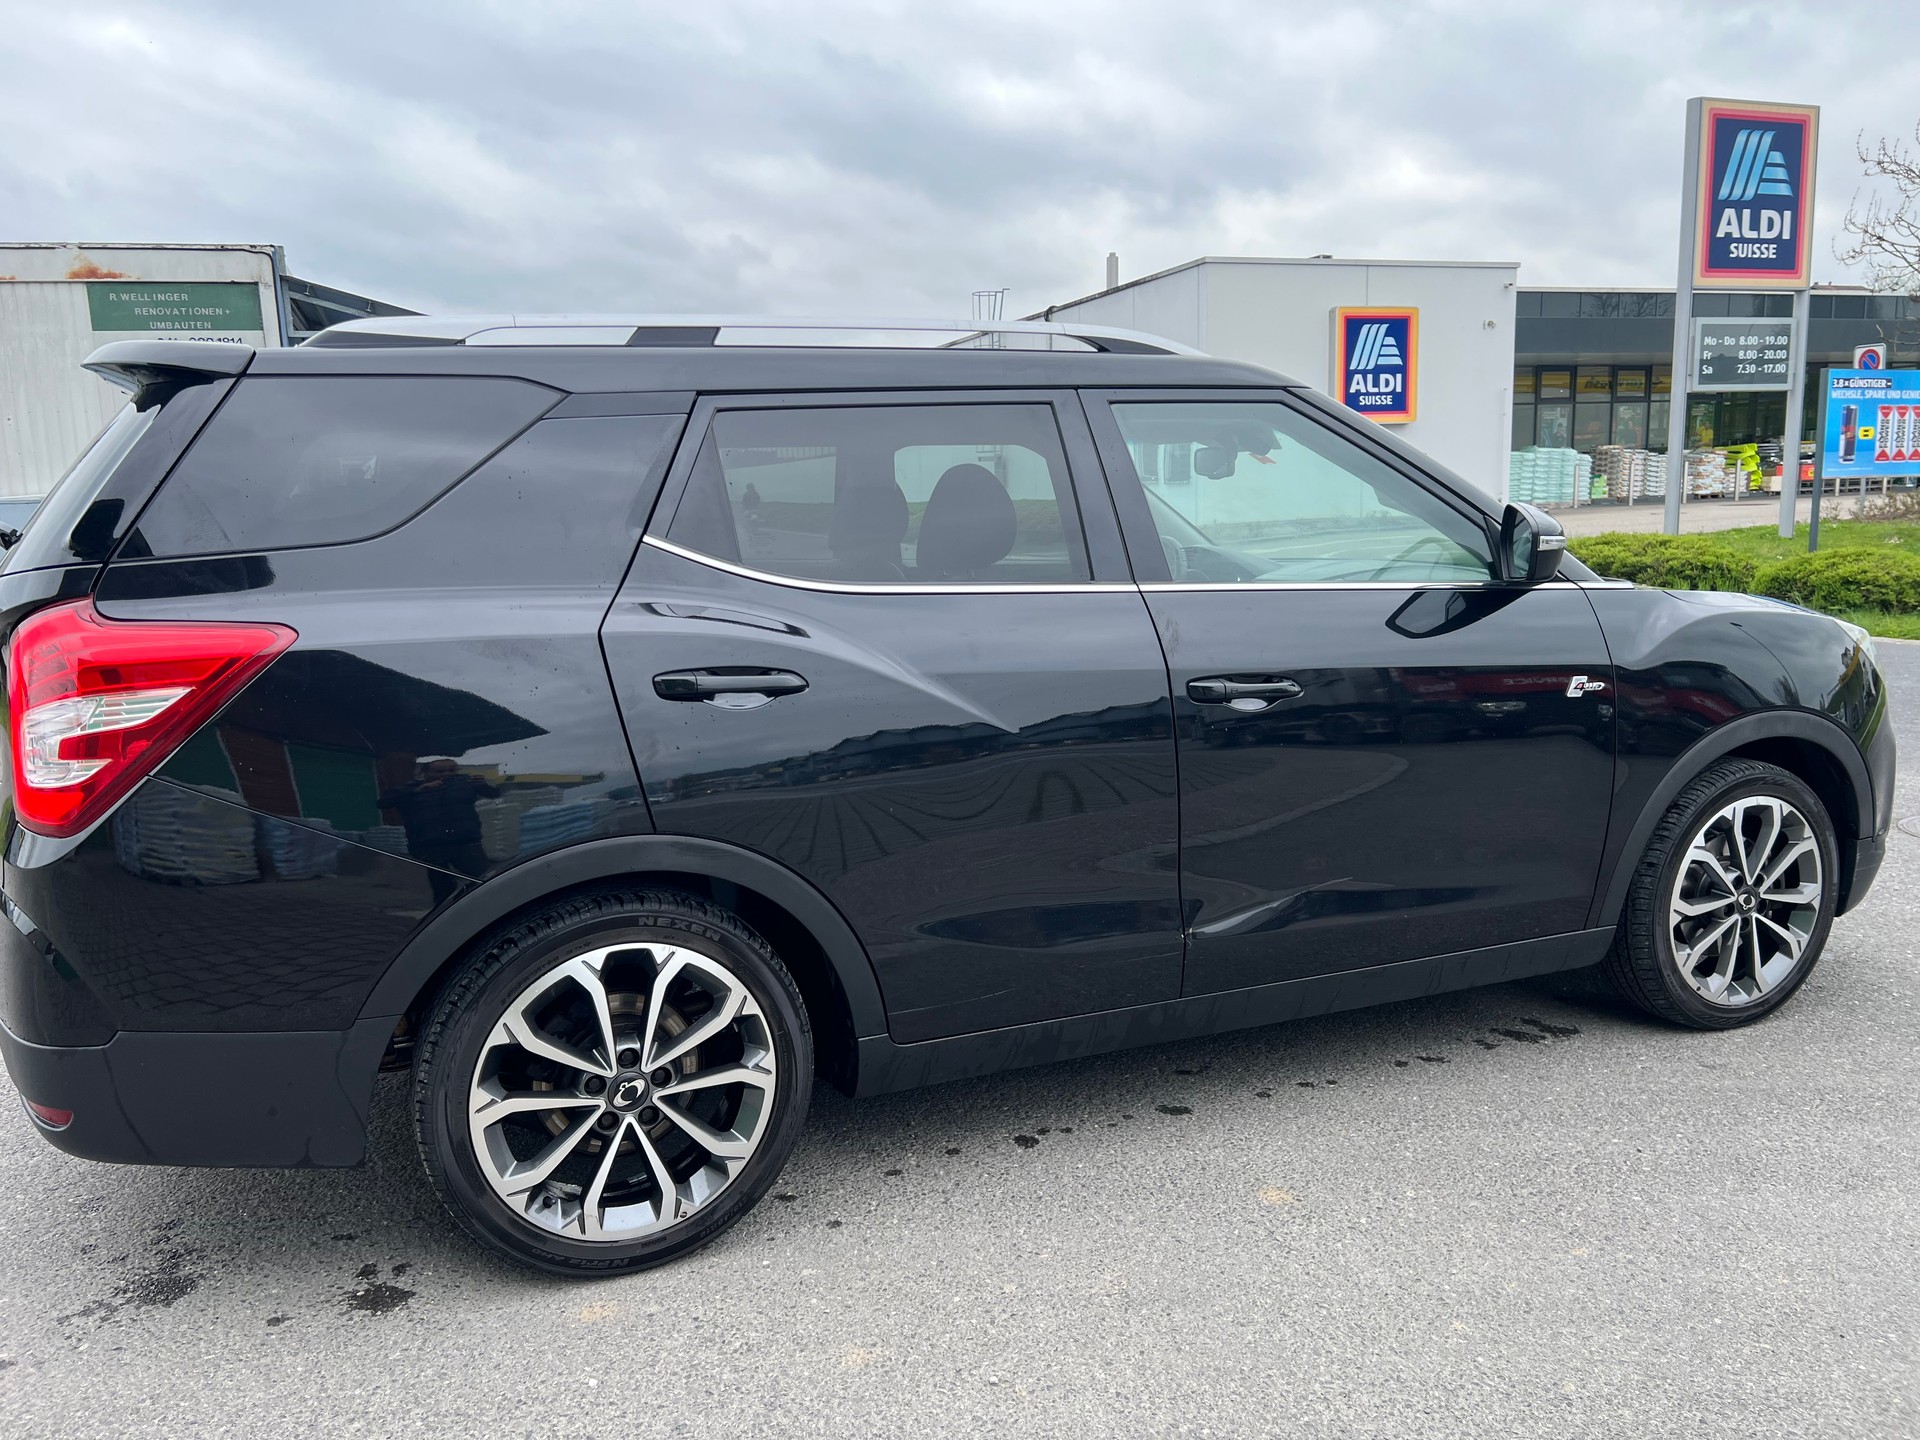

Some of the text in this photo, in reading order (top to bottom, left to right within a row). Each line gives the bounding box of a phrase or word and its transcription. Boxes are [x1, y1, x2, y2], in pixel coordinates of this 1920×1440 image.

[1716, 208, 1792, 240] ALDI
[1729, 243, 1777, 259] SUISSE
[120, 293, 188, 301] WELLINGER
[134, 307, 223, 316] RENOVATIONEN
[150, 321, 212, 330] UMBAUTEN
[1703, 336, 1717, 346] Mo
[1724, 336, 1736, 345] Do
[1739, 336, 1758, 345] 8.00
[1765, 335, 1788, 345] 19.00
[1703, 351, 1712, 360] Fr
[1738, 350, 1757, 359] 8.00
[1763, 350, 1787, 359] 20.00
[1702, 365, 1713, 374] Sa
[1737, 364, 1756, 373] 7.30
[1763, 364, 1786, 373] 17.00
[1349, 373, 1402, 393] ALDI
[1864, 390, 1885, 399] SPARE
[1887, 390, 1901, 399] UND
[1359, 395, 1393, 405] SUISSE
[638, 916, 722, 942] NEXEN
